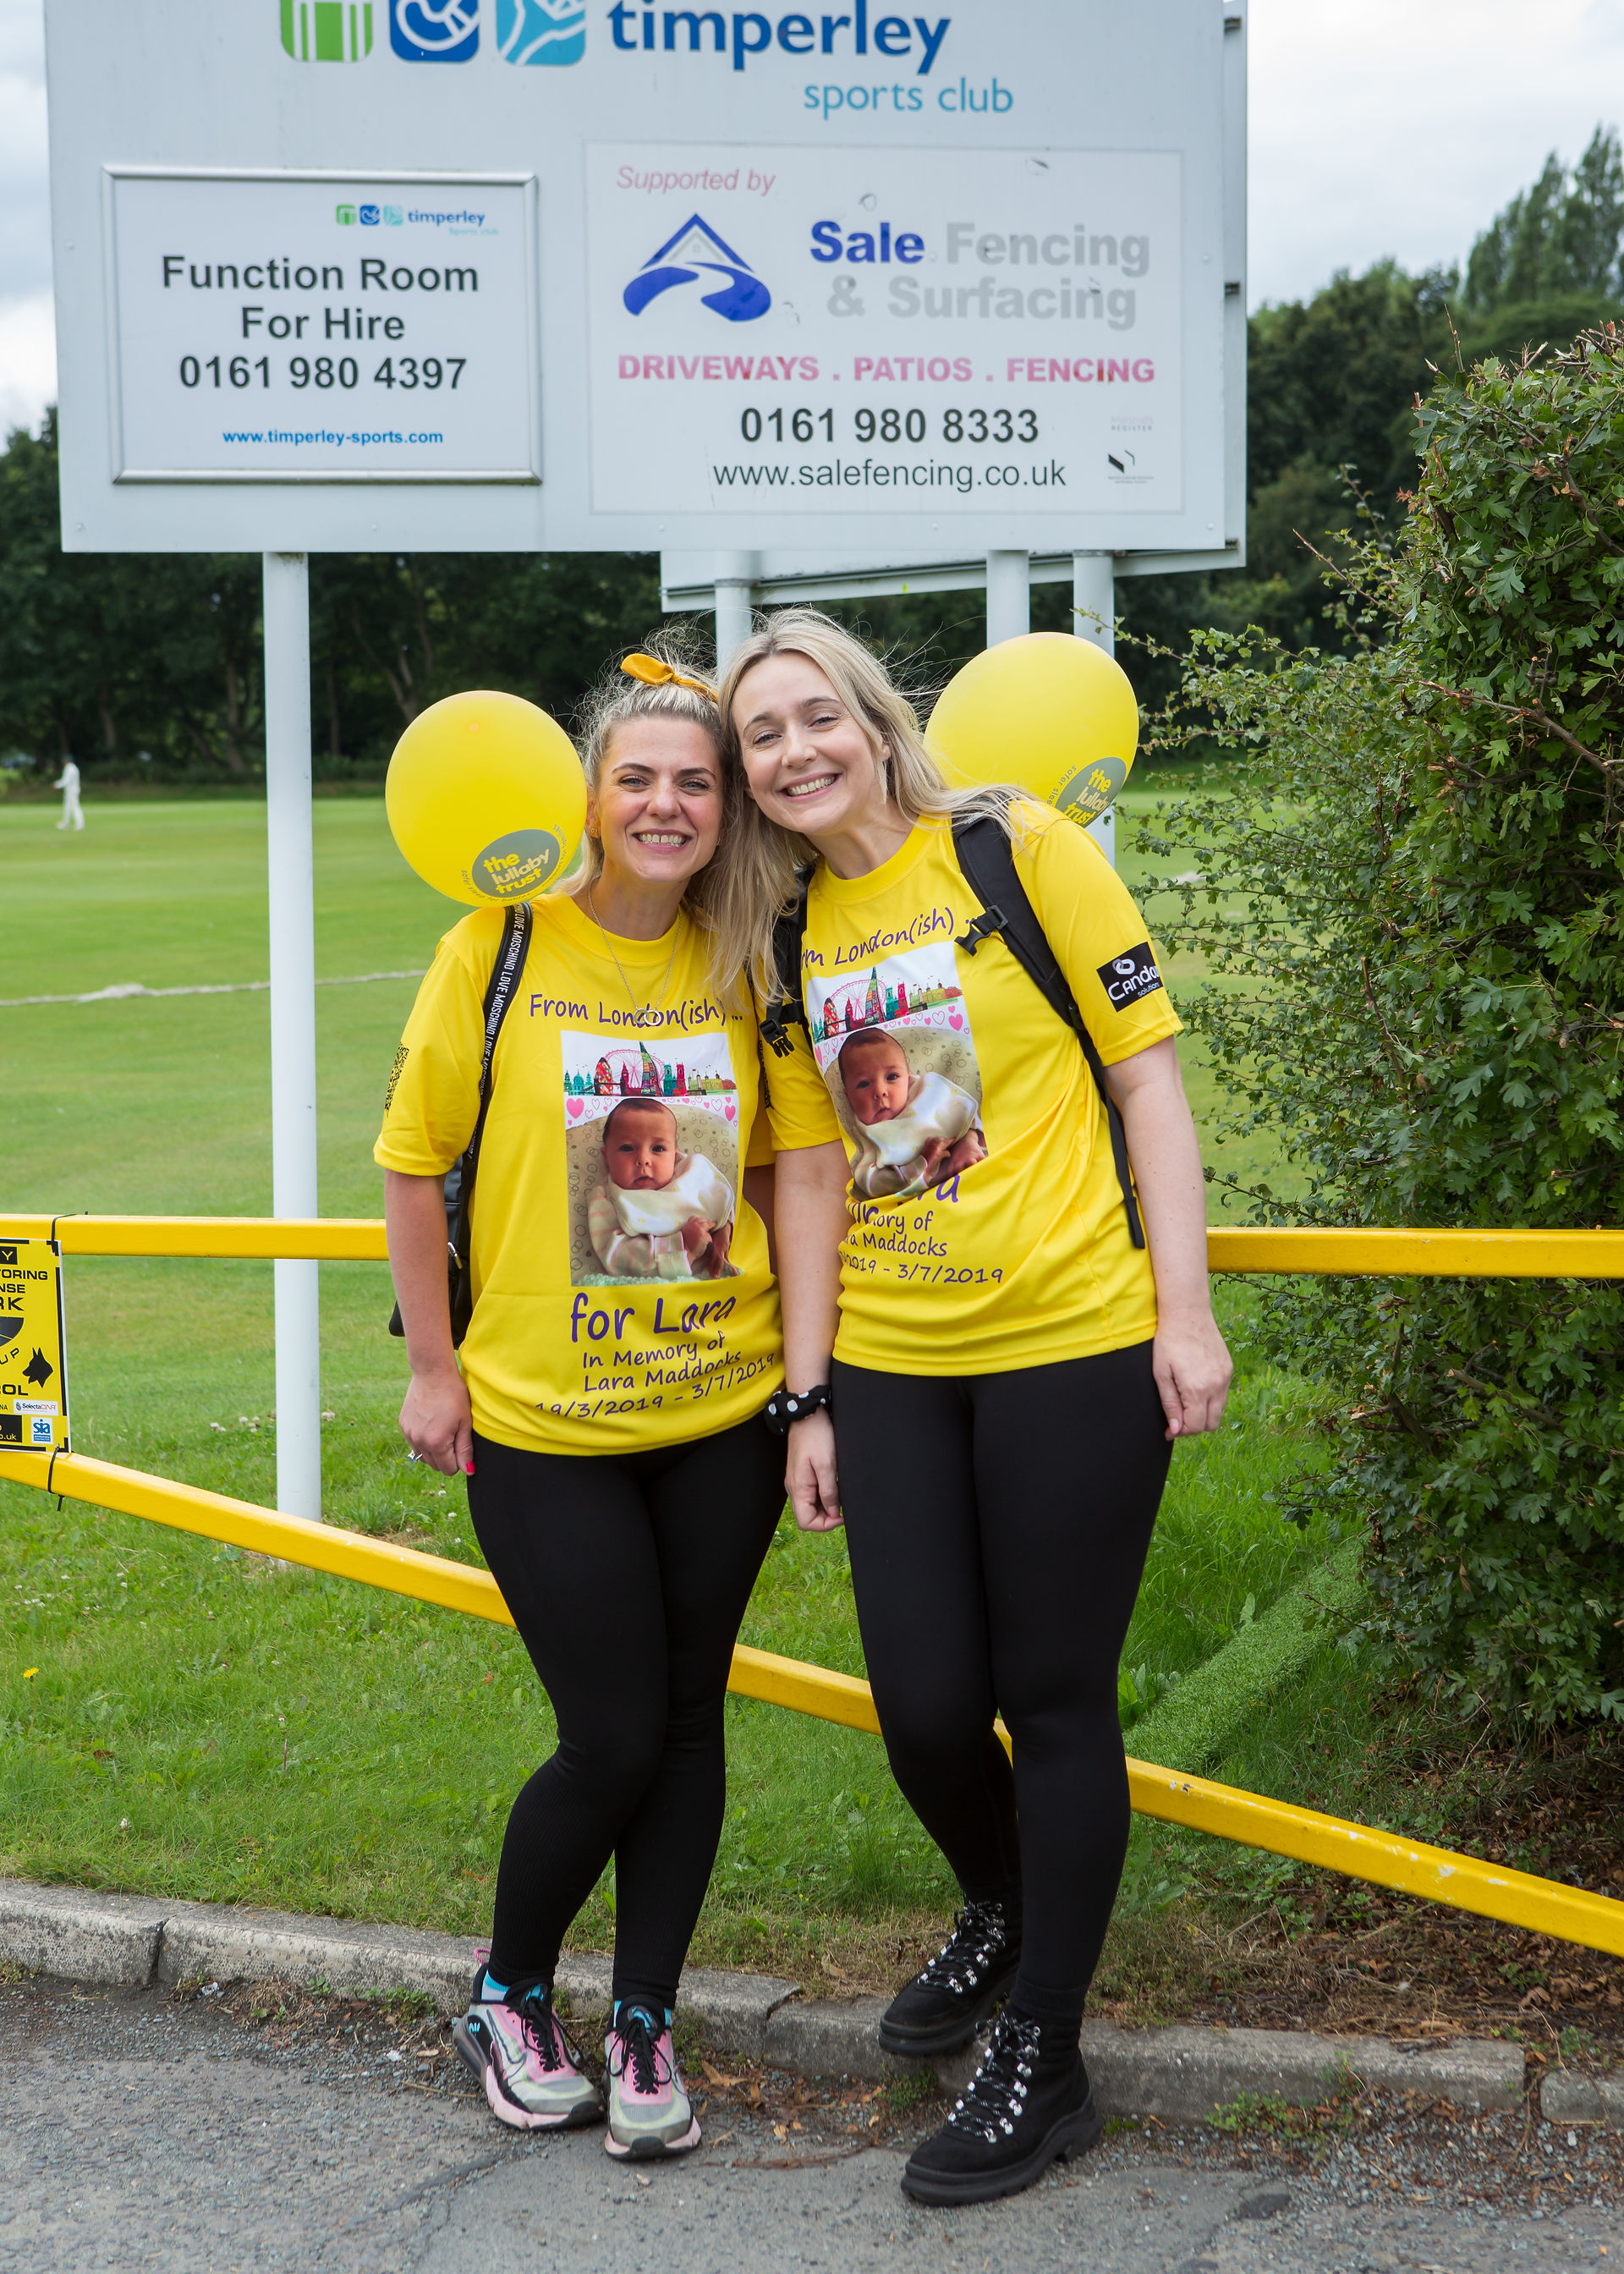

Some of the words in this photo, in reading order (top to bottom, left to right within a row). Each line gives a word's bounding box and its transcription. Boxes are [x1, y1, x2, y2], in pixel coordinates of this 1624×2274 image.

[606, 0, 951, 74] timperley
[804, 82, 923, 120] sports
[938, 77, 1013, 113] club
[616, 166, 738, 193] Supported
[747, 169, 776, 196] by
[408, 209, 486, 227] timperley
[809, 220, 925, 264] Sale
[946, 222, 1150, 277] Fencing
[162, 255, 344, 290] Function
[360, 258, 479, 292] Room
[826, 275, 865, 319] &
[887, 276, 1136, 331] Surfacing
[241, 307, 310, 339] For
[324, 308, 405, 340] Hire
[179, 355, 271, 388] 0161
[289, 356, 359, 388] 980
[374, 358, 467, 389] 4397
[617, 354, 820, 381] DRIVEWAYS
[853, 357, 973, 382] PATIOS
[1007, 357, 1156, 383] FENCING
[222, 429, 443, 446] www.timperley-sports.com
[741, 408, 836, 442] 0161
[853, 408, 927, 443] 980
[941, 409, 1040, 444] 8333
[713, 459, 1067, 493] www.salefencing.co.uk
[1088, 768, 1111, 793] the
[1075, 786, 1111, 816] lullab
[483, 853, 520, 874] the
[491, 849, 549, 885] lullaby
[495, 868, 541, 894] trust
[513, 914, 525, 931] LOVE
[504, 930, 524, 970] MOSCHINO
[497, 971, 513, 993] LOVE
[486, 993, 507, 1035] MOSCHINO
[529, 994, 589, 1020] From
[914, 1211, 934, 1231] of
[863, 1232, 947, 1256] Maddocks
[1, 1269, 48, 1280] ORING
[897, 1263, 1003, 1283] 3/7/2019
[571, 1292, 635, 1343] for
[653, 1296, 737, 1334] Lara
[583, 1352, 601, 1369] In
[613, 1343, 698, 1367] Memory
[707, 1331, 726, 1350] of
[584, 1375, 634, 1392] Lara
[645, 1351, 742, 1387] Maddocks
[692, 1353, 775, 1400] 3/7/2019
[33, 1419, 51, 1434] sia
